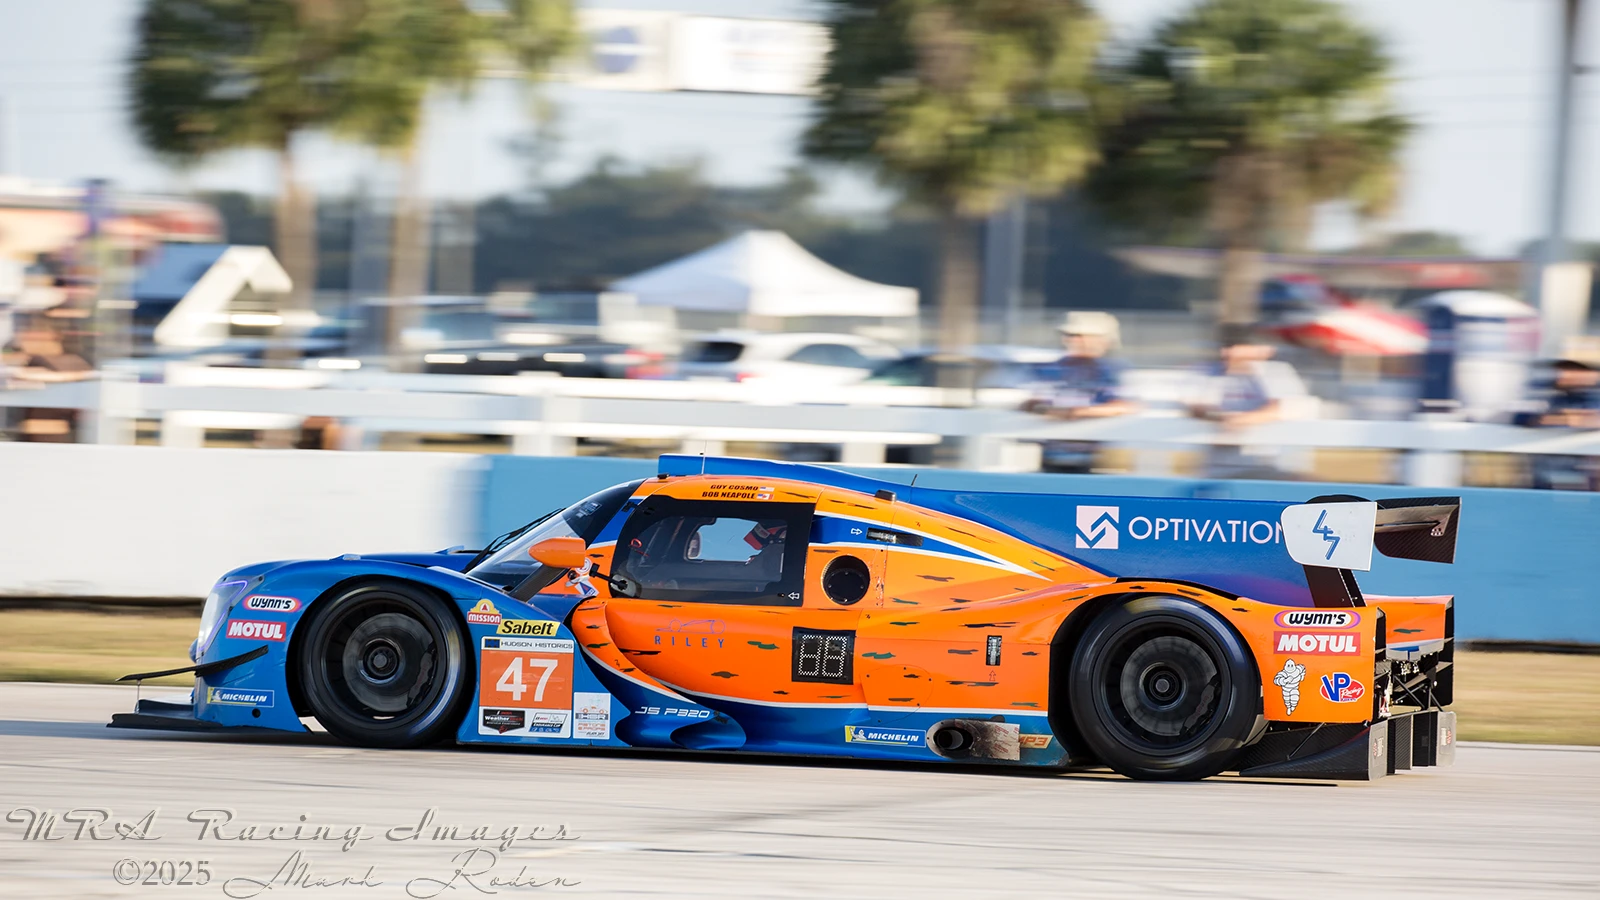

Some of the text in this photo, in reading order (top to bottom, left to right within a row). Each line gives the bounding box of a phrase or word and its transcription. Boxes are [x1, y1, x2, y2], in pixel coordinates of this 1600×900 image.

[228, 621, 284, 639] MOTUL
[501, 620, 554, 635] Sabelt
[534, 642, 573, 650] HISTORICS
[1276, 634, 1358, 653] MOTUL
[496, 657, 558, 702] 47
[1321, 673, 1351, 702] VP
[221, 693, 268, 703] MICHELIN
[635, 706, 710, 718] JS P320
[868, 732, 919, 742] MICHELIN
